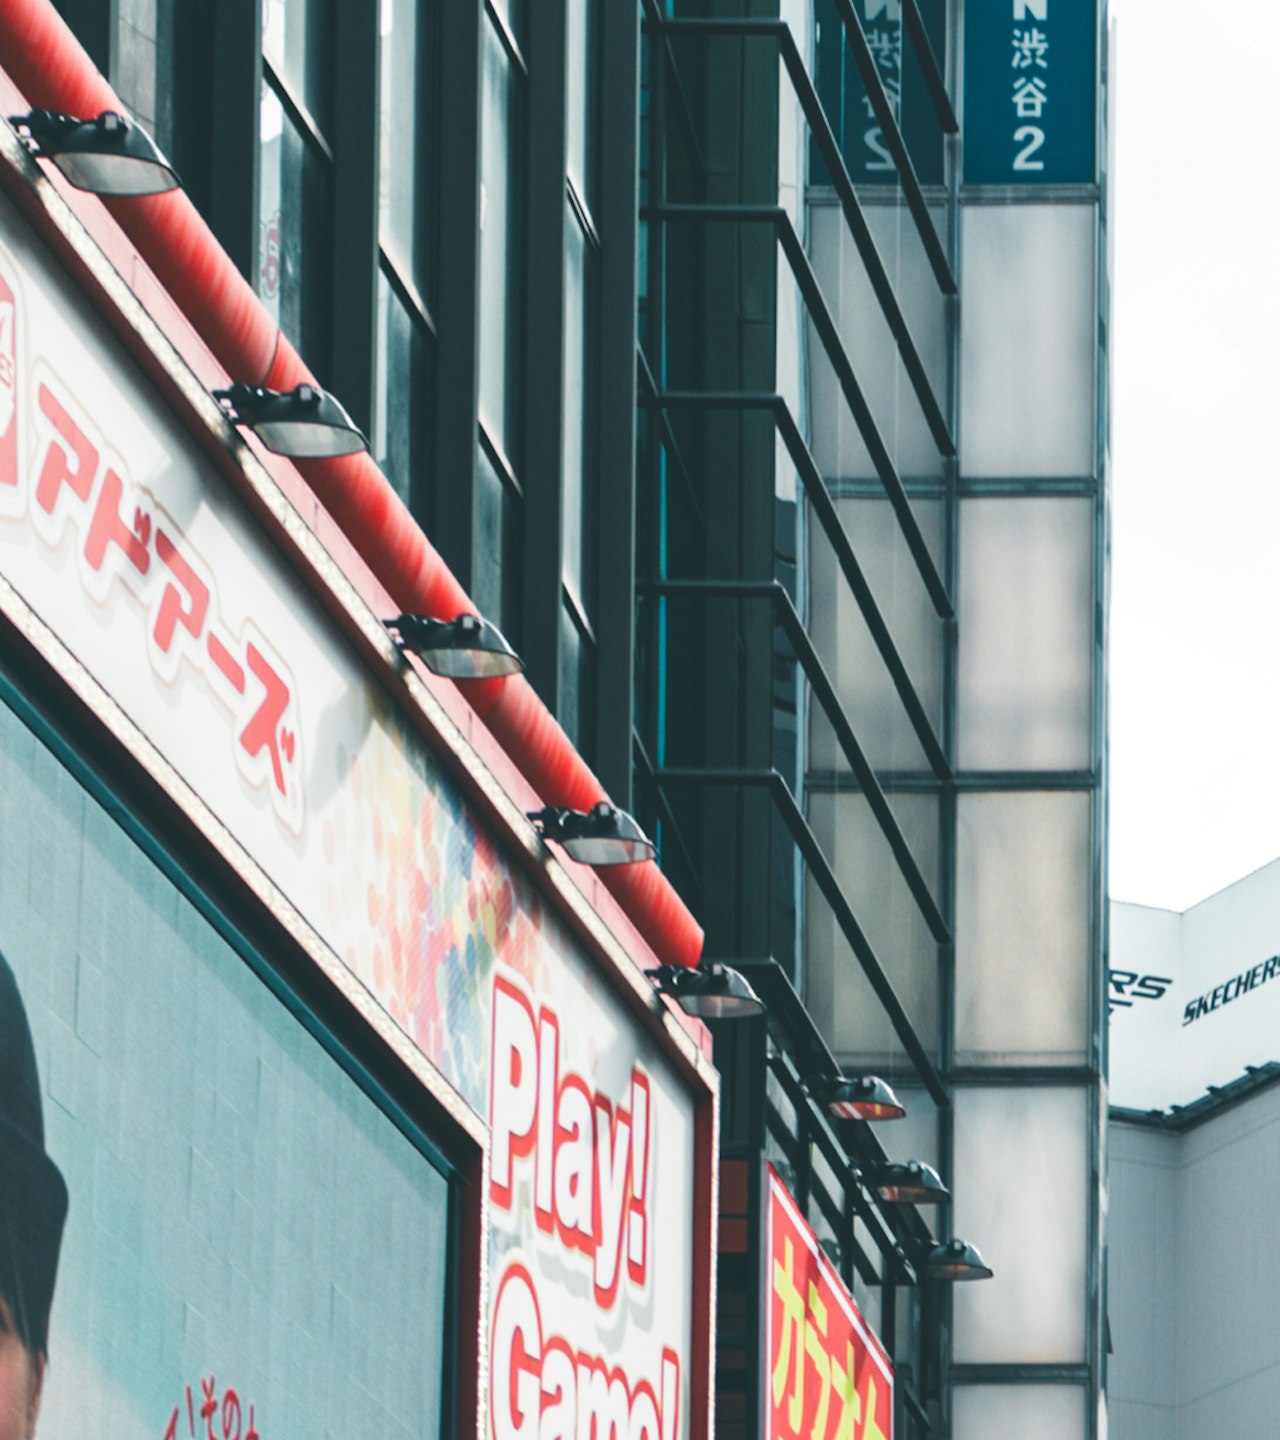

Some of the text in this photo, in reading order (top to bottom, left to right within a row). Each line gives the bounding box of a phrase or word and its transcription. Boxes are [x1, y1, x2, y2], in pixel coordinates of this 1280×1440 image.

[36, 382, 295, 797] アドアーズ
[491, 972, 650, 1309] Play!
